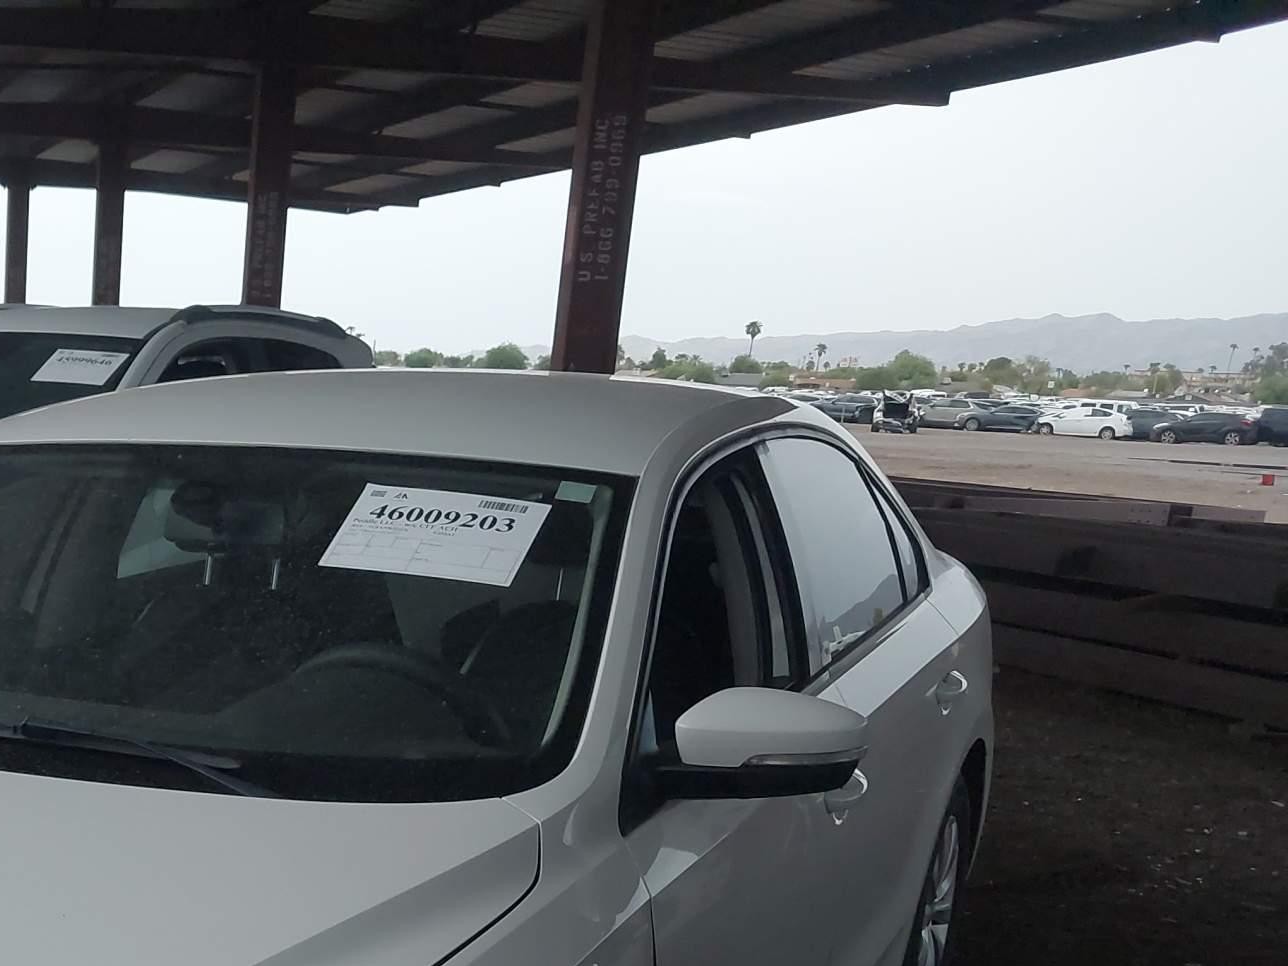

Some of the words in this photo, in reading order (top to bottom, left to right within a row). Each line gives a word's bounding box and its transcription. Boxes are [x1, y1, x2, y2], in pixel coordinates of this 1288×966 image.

[582, 159, 604, 235] PREFAB
[593, 119, 610, 150] INC
[368, 503, 516, 533] 46009203
